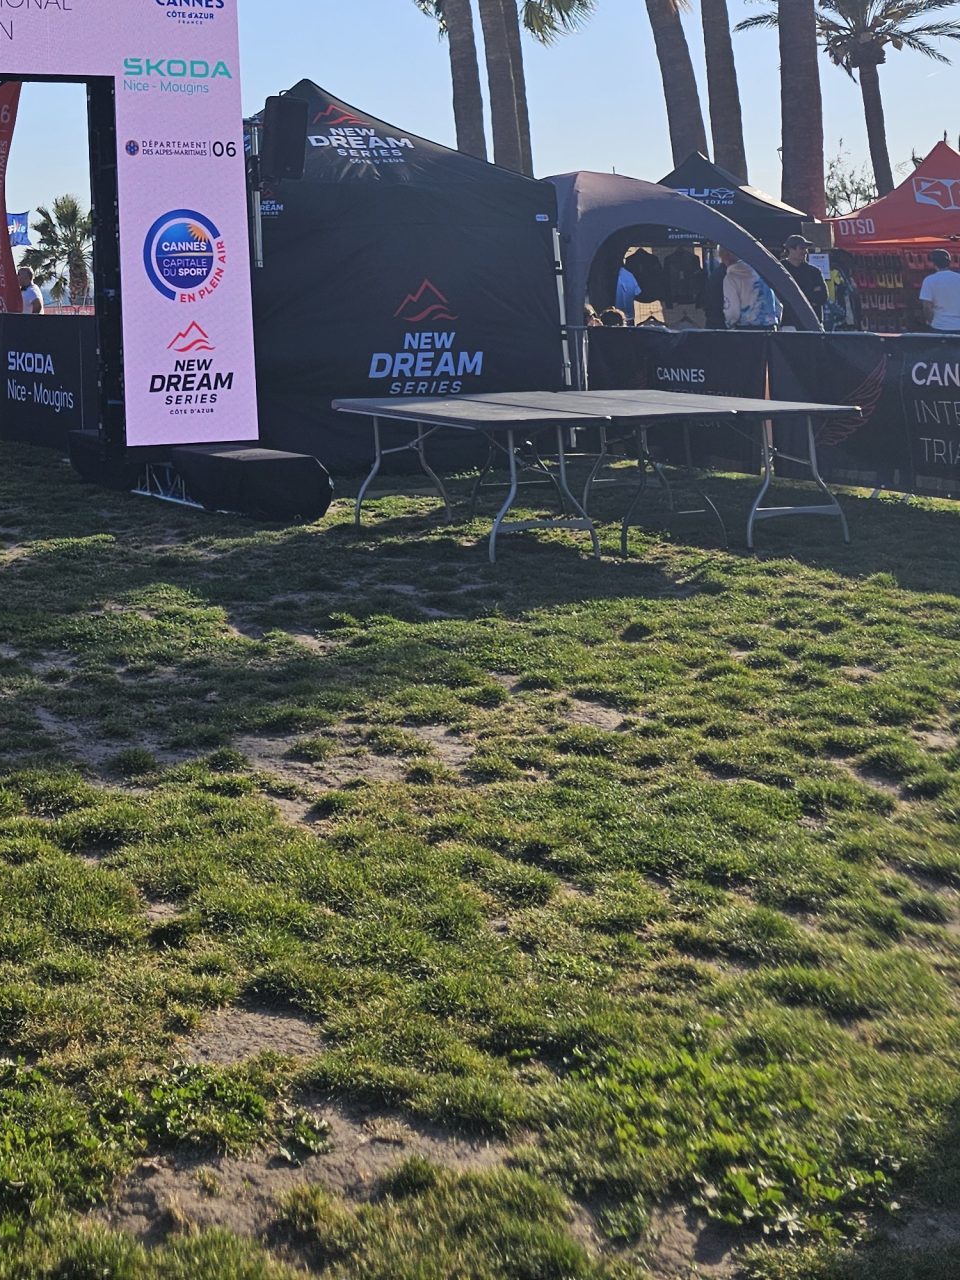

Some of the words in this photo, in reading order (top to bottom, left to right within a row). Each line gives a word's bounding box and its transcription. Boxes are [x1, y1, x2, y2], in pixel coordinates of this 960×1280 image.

[166, 10, 186, 19] CÔTE
[123, 80, 149, 92] Nice
[160, 81, 209, 96] Mougins
[329, 127, 375, 137] NEW
[142, 138, 207, 149] DÉPARTEMENT
[212, 141, 237, 158] 06
[307, 135, 415, 149] DREAM
[155, 148, 207, 156] ALPES-MARITIMES
[337, 149, 403, 158] SERIES
[162, 241, 207, 252] CANNES
[162, 258, 208, 268] CAPITALE
[162, 268, 177, 277] DU
[178, 268, 208, 277] SPORT
[180, 293, 196, 303] EN
[198, 268, 225, 301] PLEIN
[217, 241, 226, 265] AIR
[403, 332, 456, 349] NEW
[174, 358, 213, 372] NEW
[368, 351, 483, 379] DREAM
[656, 367, 705, 383] CANNES
[149, 372, 234, 393] DREAM
[389, 381, 463, 394] SERIES
[7, 378, 26, 401] Nice
[33, 381, 74, 413] Mougins
[165, 393, 218, 406] SERIES
